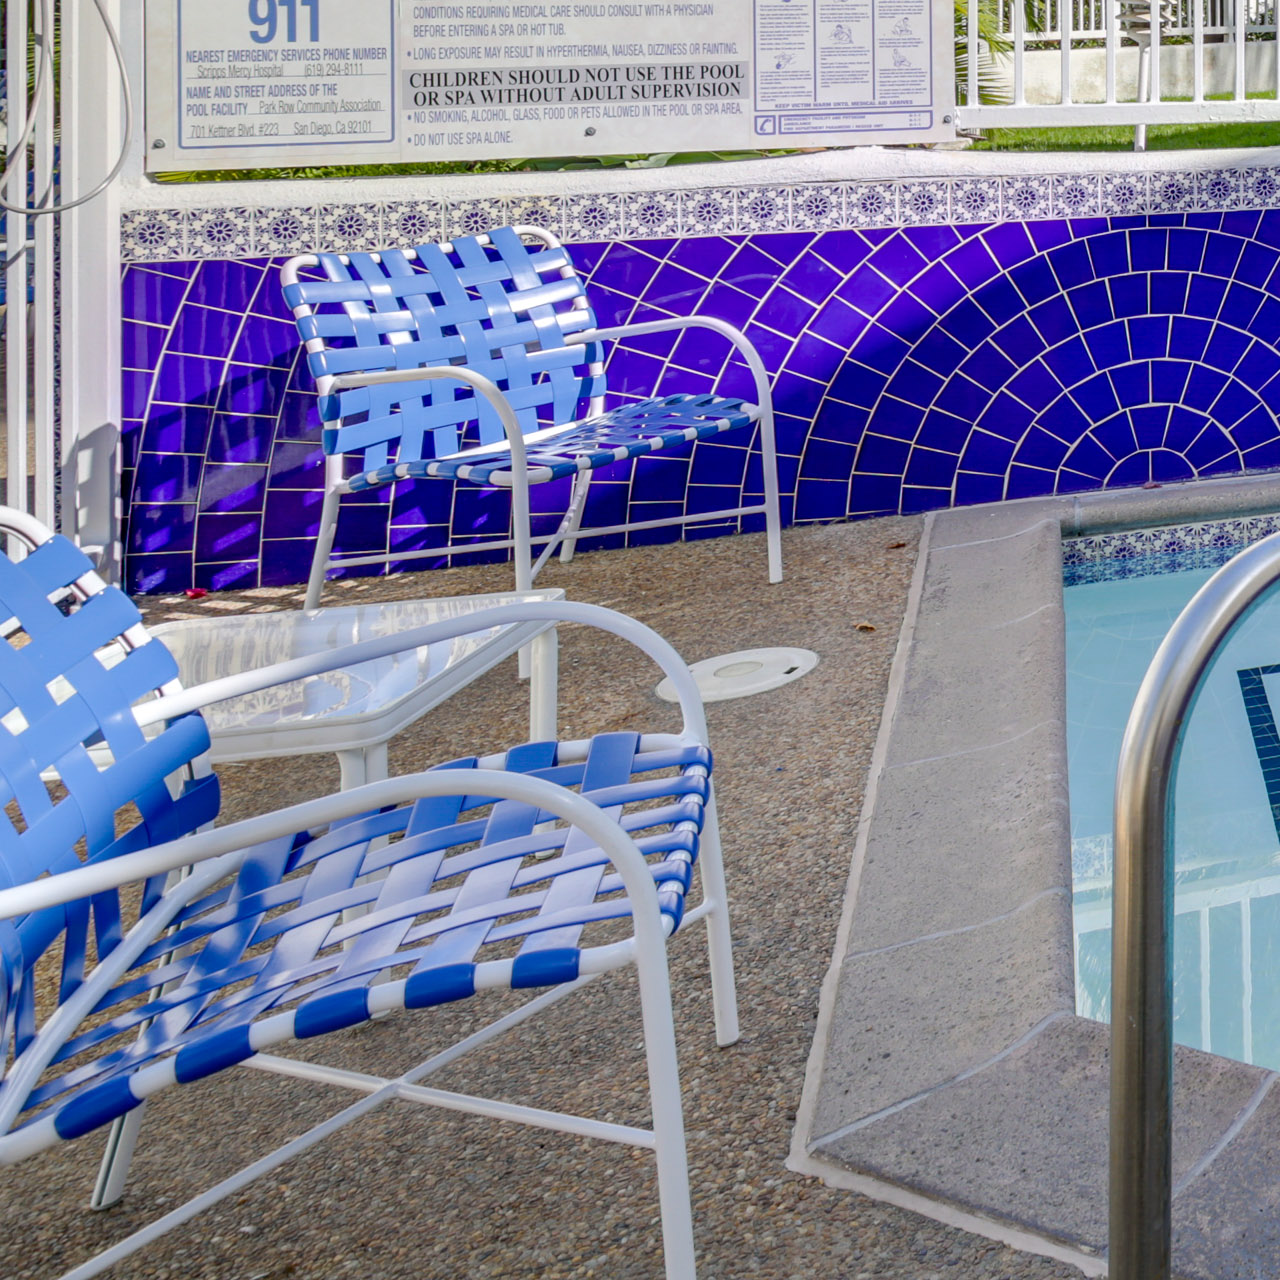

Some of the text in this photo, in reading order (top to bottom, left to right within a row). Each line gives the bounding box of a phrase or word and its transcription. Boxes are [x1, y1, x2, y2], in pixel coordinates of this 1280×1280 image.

[414, 4, 713, 18] CONDITIONS REQUIRING MEDICAL CARE SHOULD CONSULT WITH A PHYSICIAN
[414, 24, 566, 37] BEFORE ENTERING A SPA OR HOT TUB.
[187, 48, 387, 63] NEAREST EMERGENCY SERVICES PHONE NUMBER
[414, 42, 738, 60] LONG EXPOSURE MAY RESULT IN HYPERTHERMIA, NAUSEA, DIZZINESS OR FAINTING.
[197, 63, 363, 79] Scripps Mercy Hospital (619) 294-8111
[410, 65, 744, 88] CHILDREN SHOULD NOT USE THE POOL
[187, 83, 337, 99] NAME AND STREET ADDRESS OF THE
[414, 91, 440, 107] OR
[445, 90, 476, 105] SPA
[480, 87, 565, 104] WITHOUT
[570, 85, 627, 101] ADULT
[631, 82, 741, 99] SUPERVISION
[187, 99, 381, 116] POOL FACILITY Park Row Community Association
[414, 103, 742, 125] NO SMOKING, ALCOHOL, GLASS, FOOD OR PETS ALLOWED IN THE POOL OR SPA AREA.
[191, 125, 205, 138] 701
[208, 124, 235, 137] Kettner
[259, 123, 279, 136] #223
[294, 122, 310, 135] San
[336, 121, 346, 134] Ca
[348, 121, 372, 133] 92101
[414, 131, 513, 146] DO NOT USE SPA ALONE.
